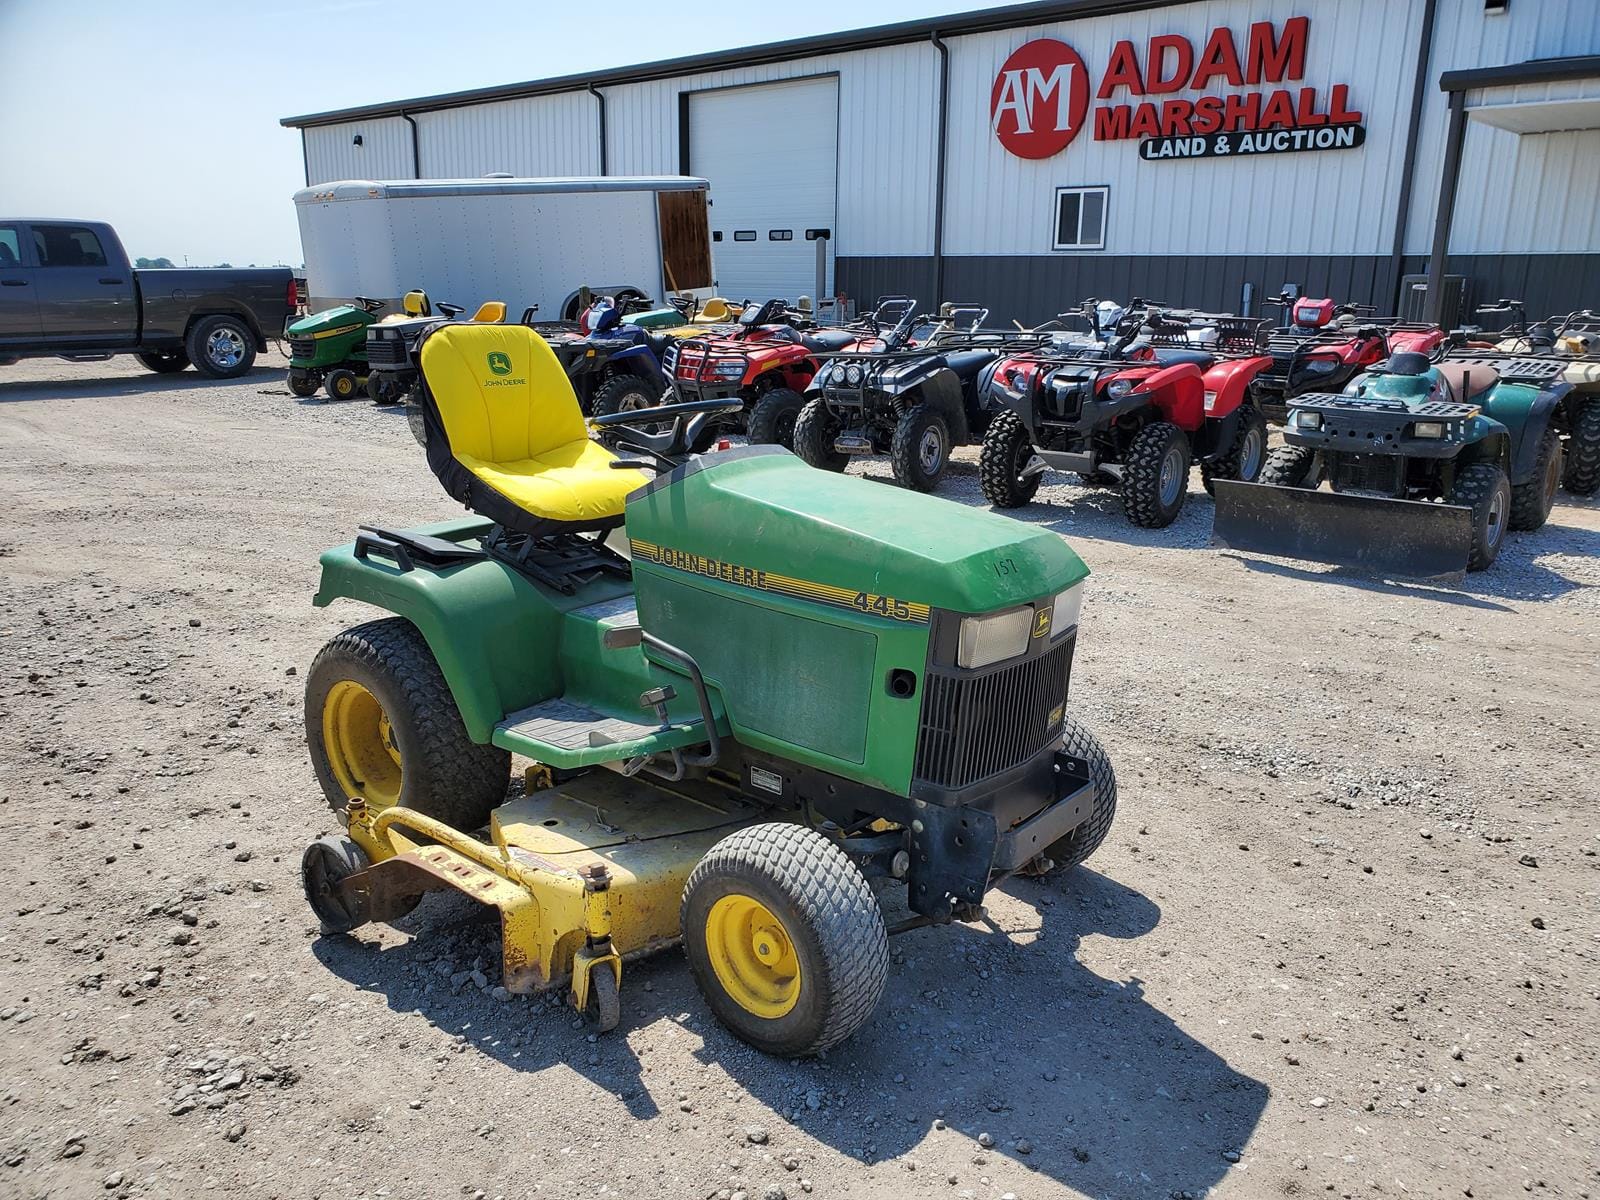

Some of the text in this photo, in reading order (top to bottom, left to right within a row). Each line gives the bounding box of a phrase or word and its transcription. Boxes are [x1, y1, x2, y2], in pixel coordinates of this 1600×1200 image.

[1096, 16, 1309, 99] ADAM
[992, 63, 1076, 135] AM
[1094, 83, 1362, 141] MARSHALL
[1146, 126, 1355, 158] LAND & AUCTION
[484, 378, 527, 387] JOHN DEERE
[651, 545, 768, 590] JOHN DEERE
[993, 558, 1019, 578] 157
[853, 591, 911, 622] 445
